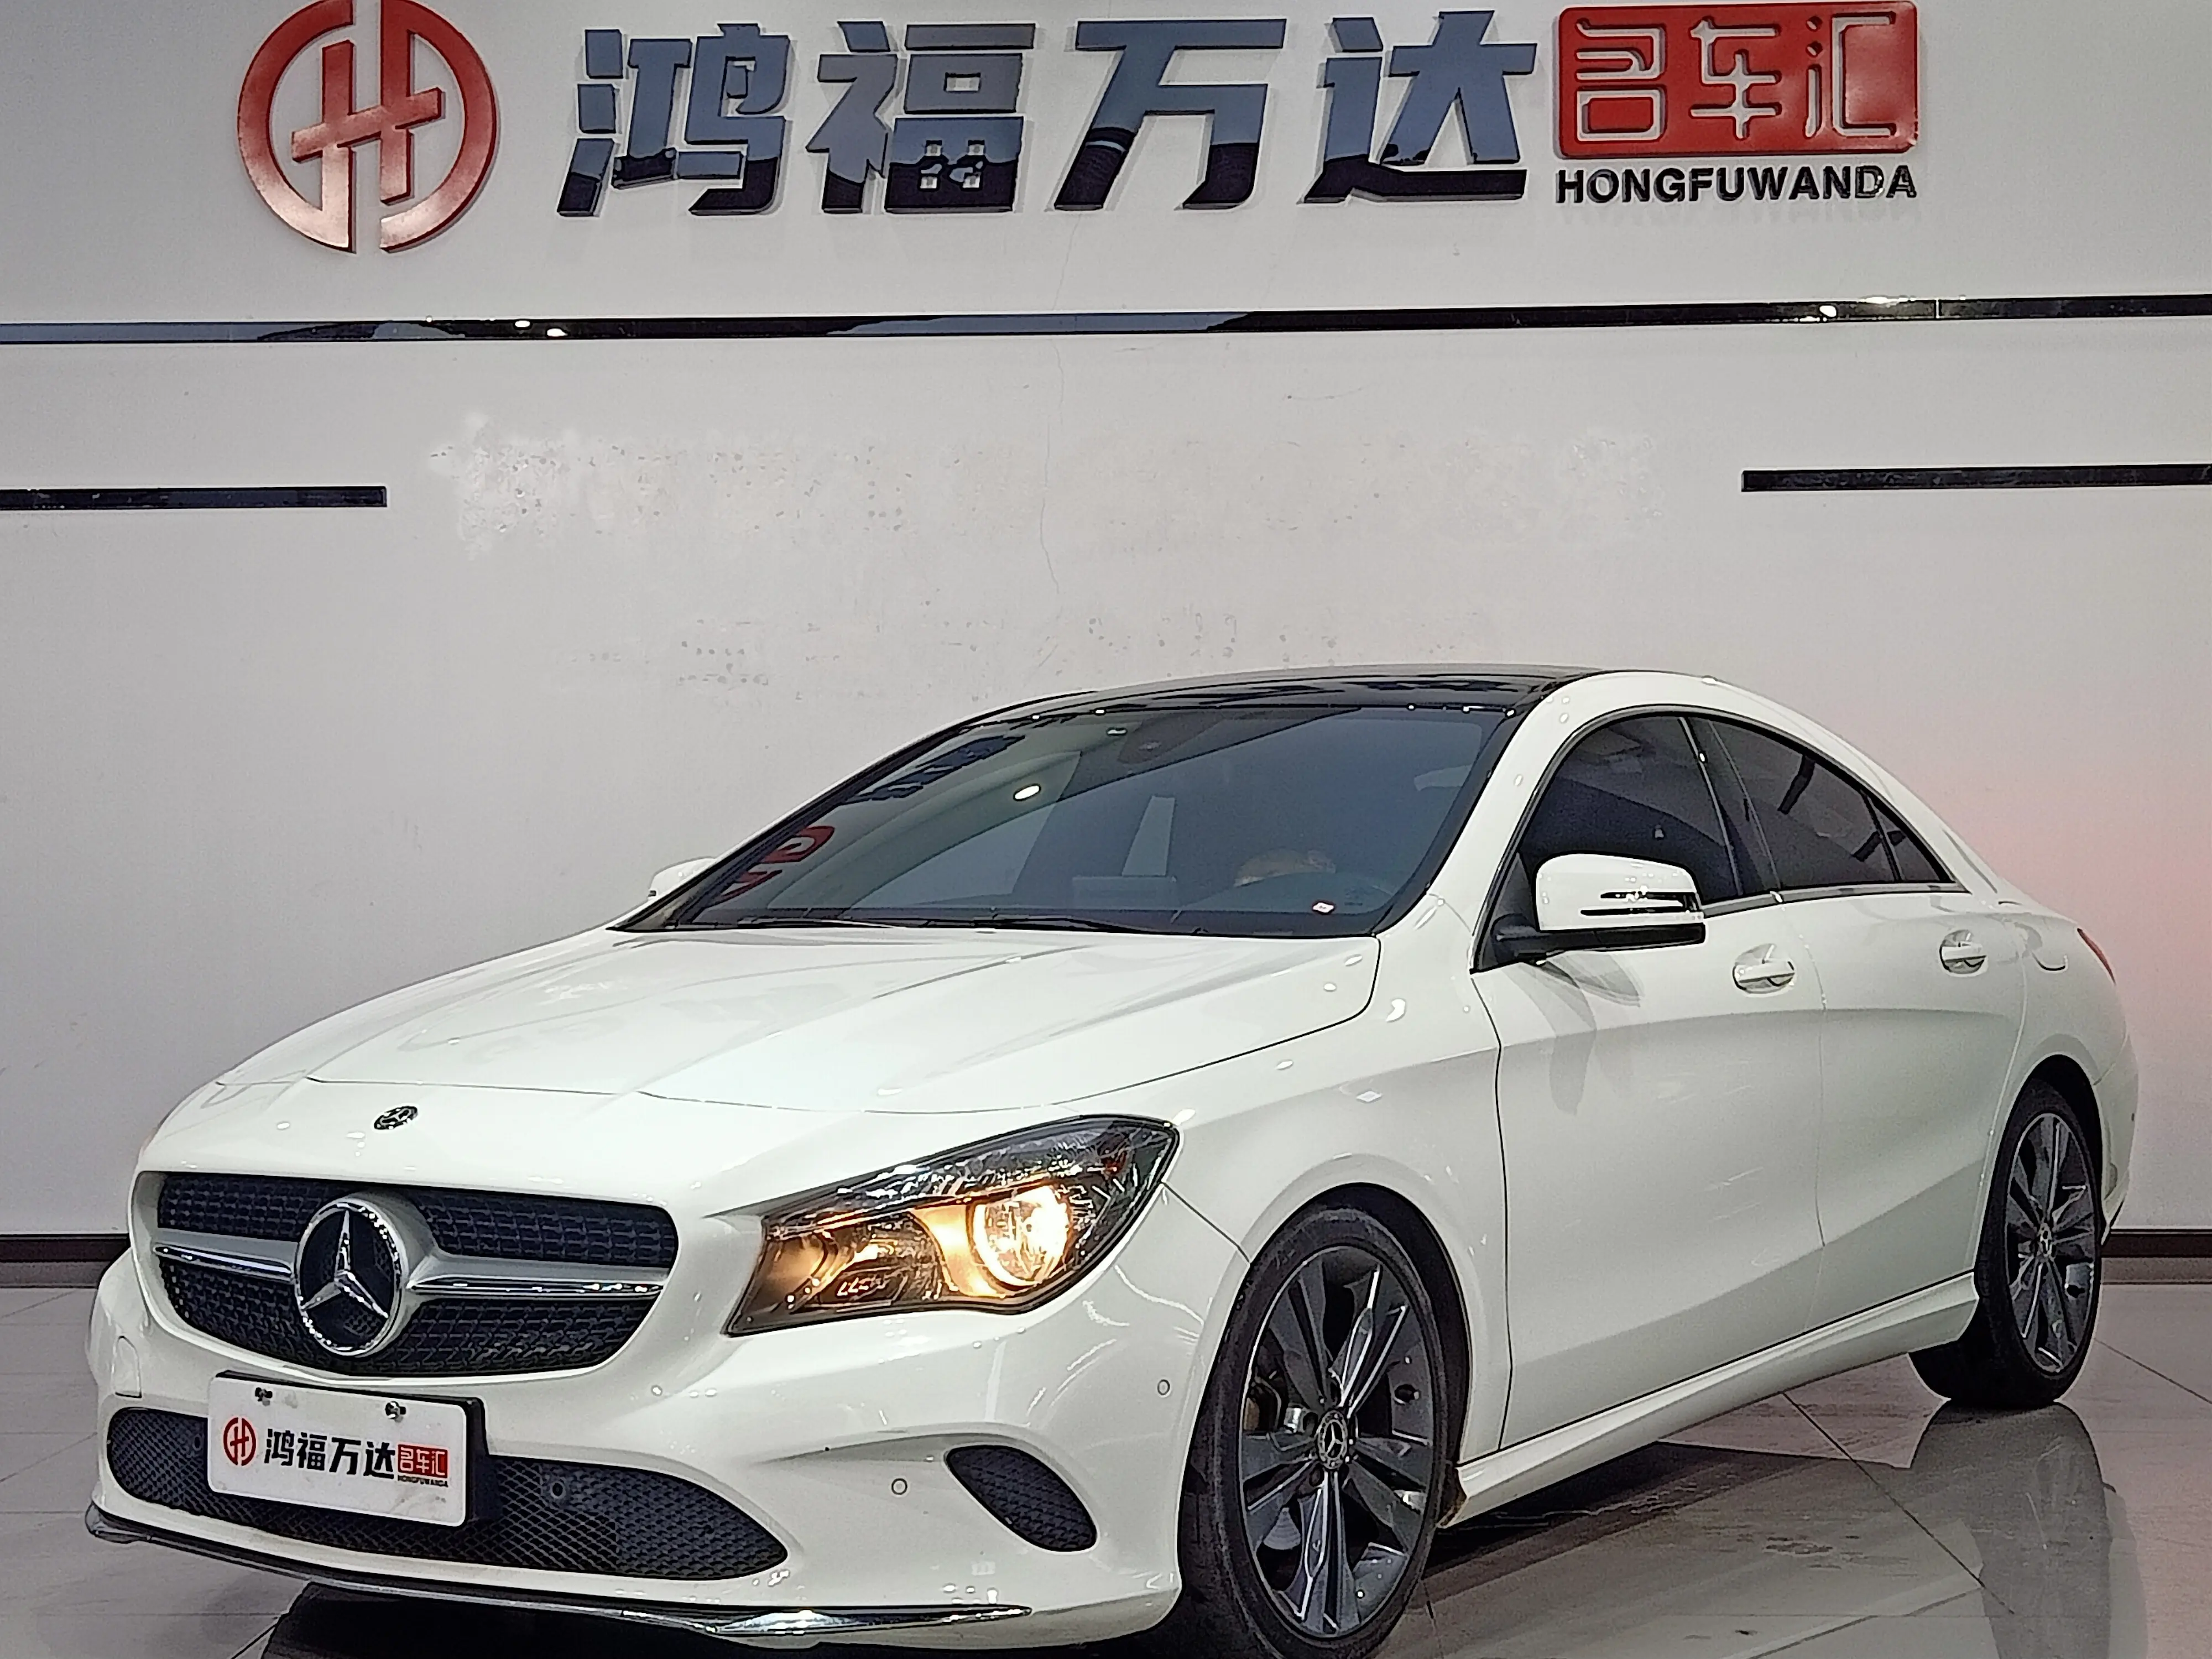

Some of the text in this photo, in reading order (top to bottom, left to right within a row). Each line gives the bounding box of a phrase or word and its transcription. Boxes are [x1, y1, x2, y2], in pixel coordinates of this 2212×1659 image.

[1573, 14, 1900, 140] 名车汇
[557, 11, 1537, 215] 鸿福万达
[1556, 165, 1917, 204] HONGFUWANDA
[264, 1428, 395, 1479] 鸿福万达
[400, 1447, 446, 1476] 名车汇
